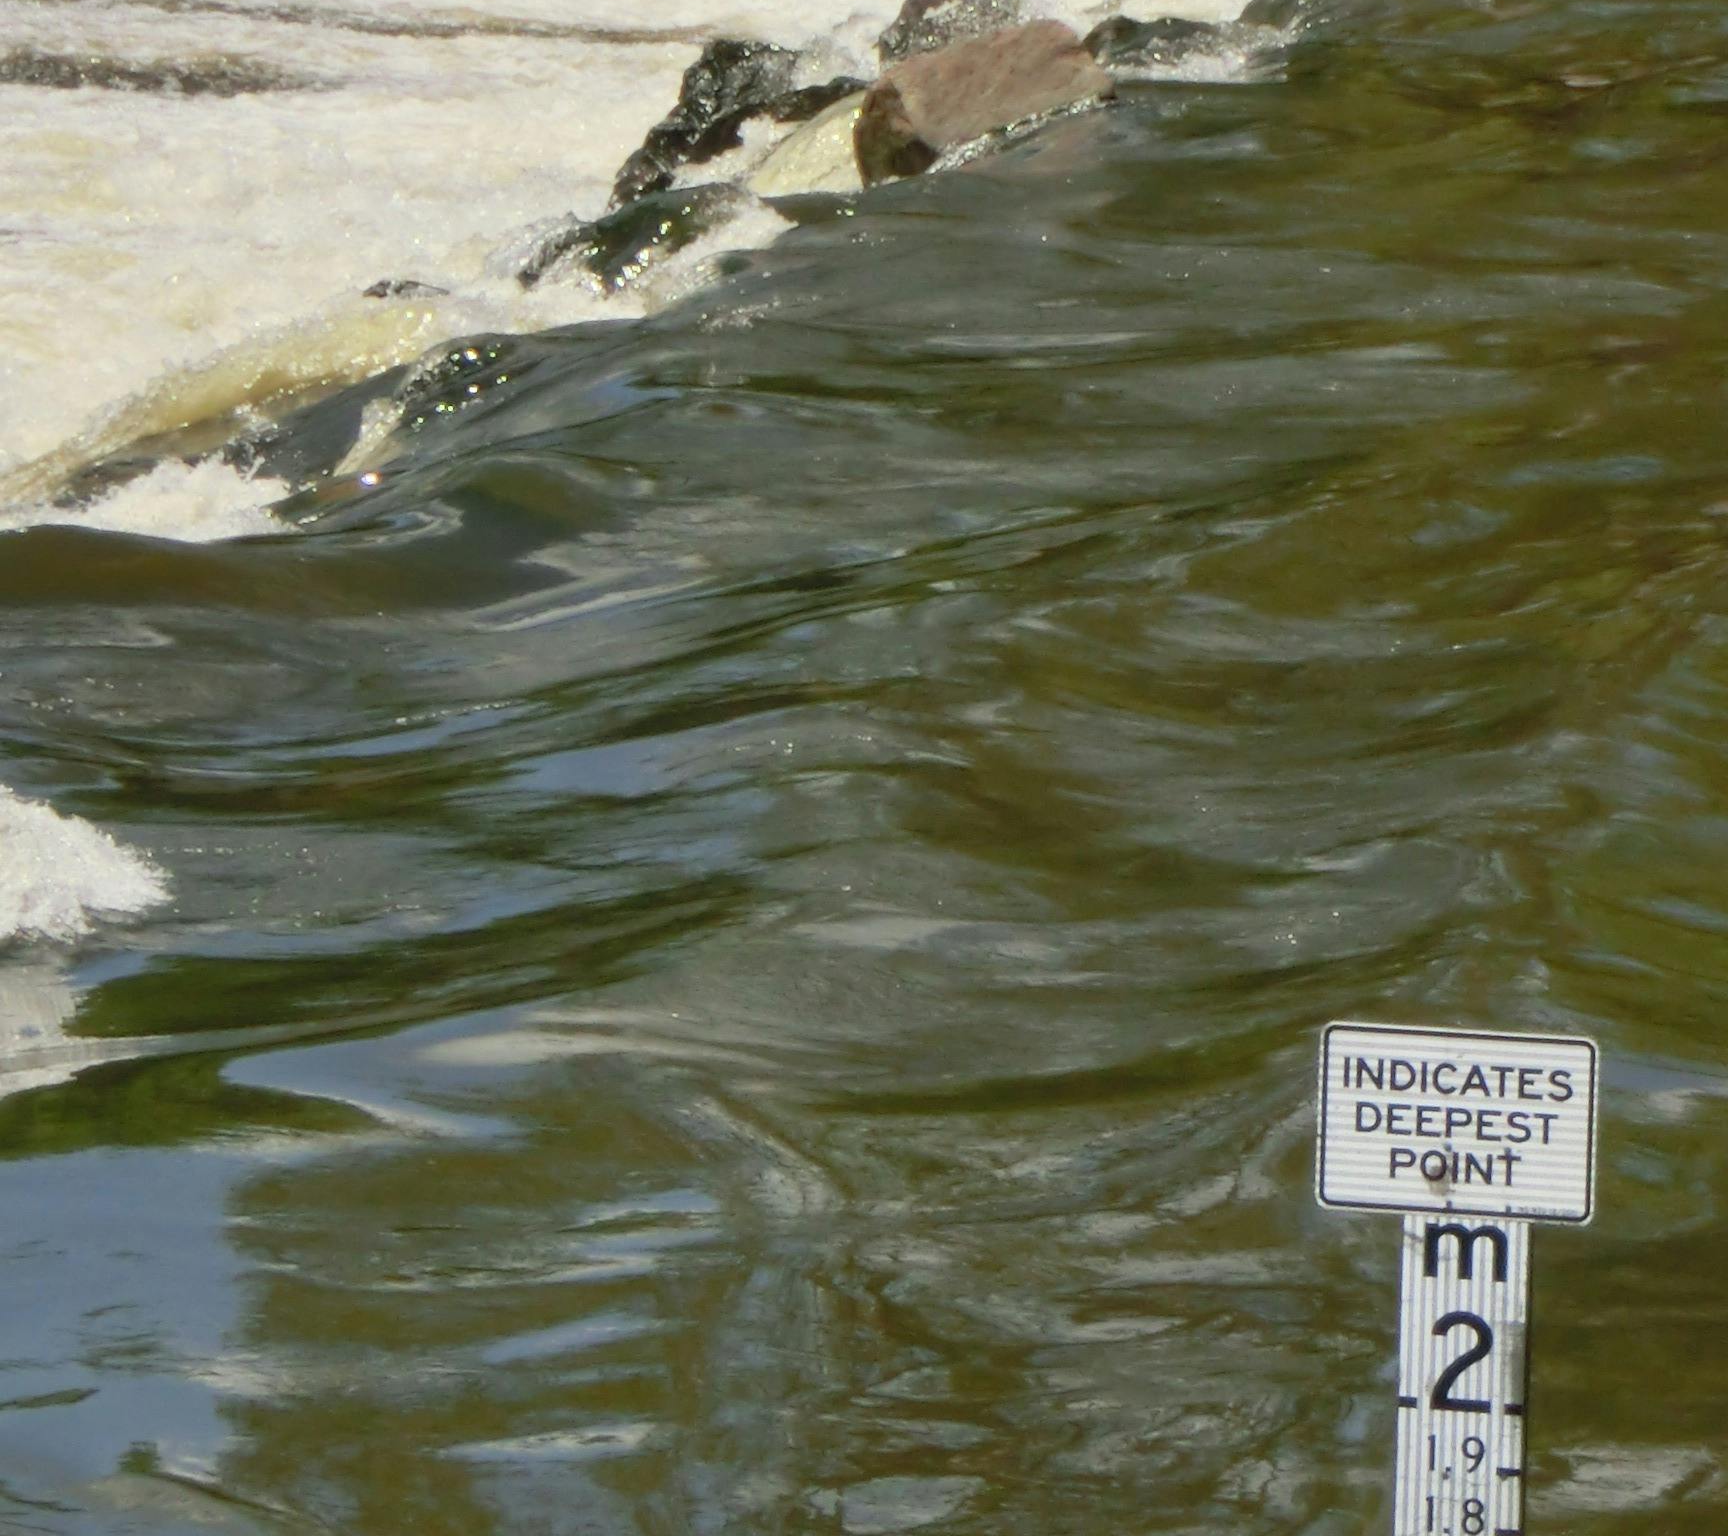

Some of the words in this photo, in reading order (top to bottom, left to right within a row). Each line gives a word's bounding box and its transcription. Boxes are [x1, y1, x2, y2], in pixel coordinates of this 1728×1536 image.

[1342, 1055, 1574, 1103] INDICATES
[1355, 1102, 1559, 1145] DEEPEST
[1388, 1147, 1523, 1187] POINT
[1423, 1221, 1509, 1283] m
[1429, 1310, 1494, 1414] 2
[1426, 1433, 1486, 1476] 1.9
[1424, 1494, 1486, 1536] 1.8
